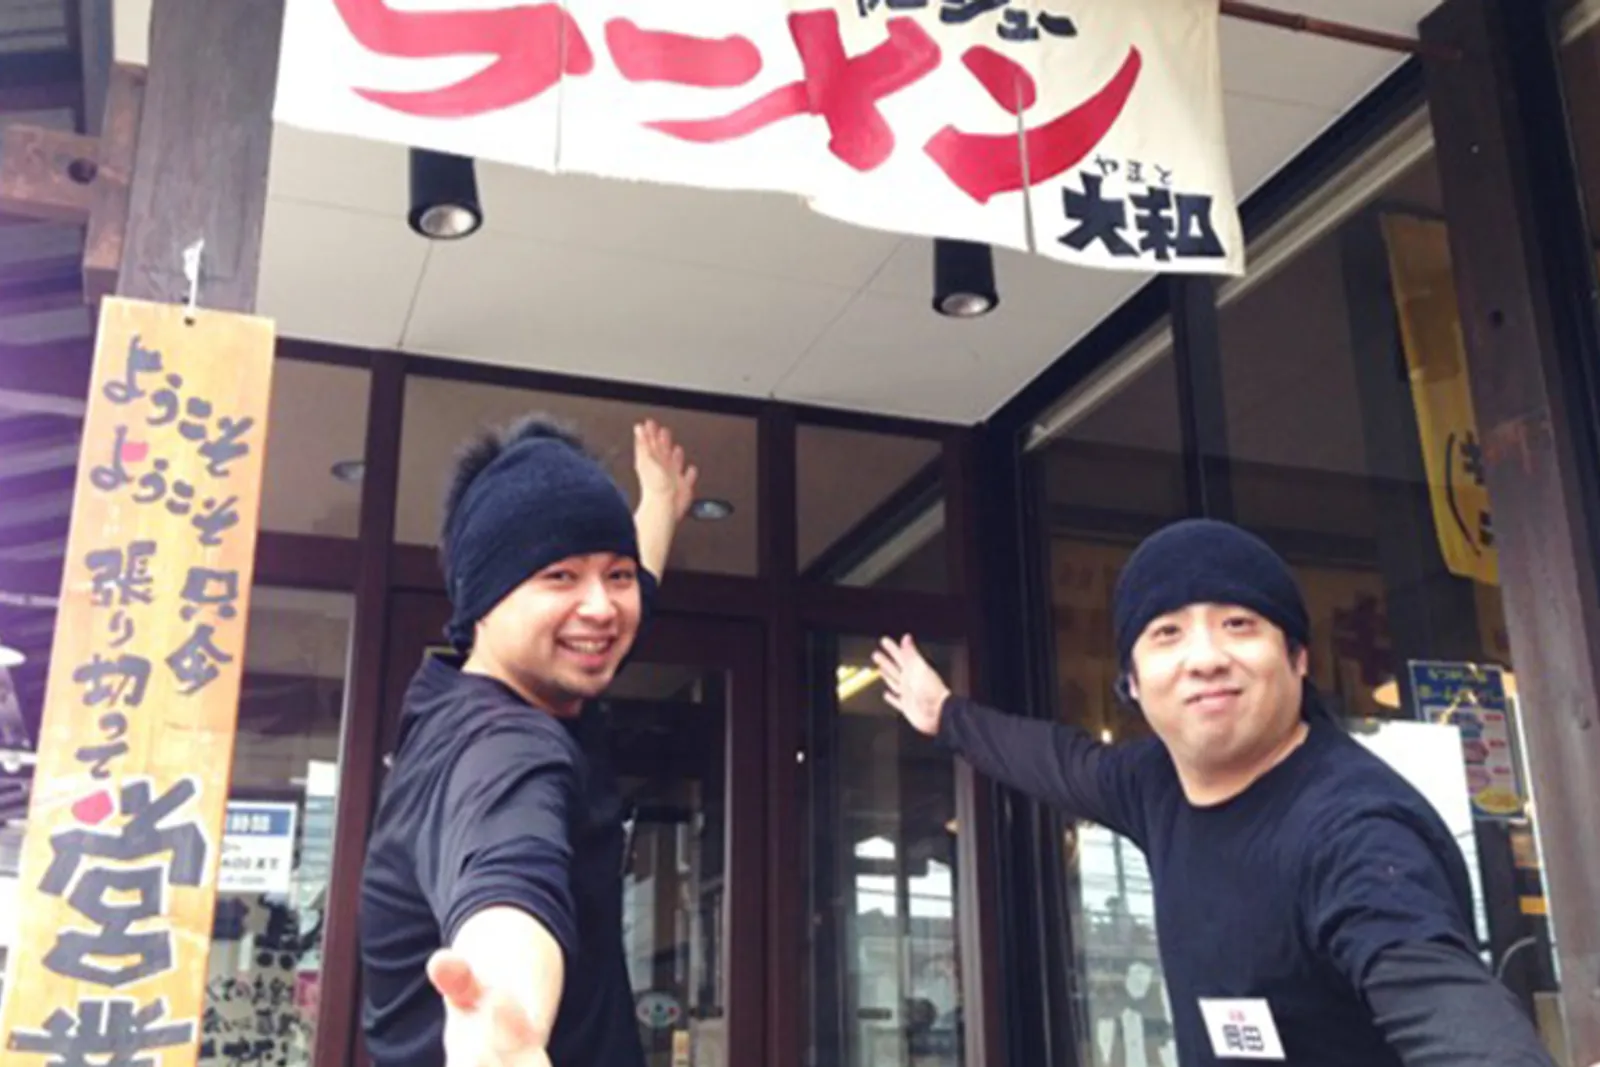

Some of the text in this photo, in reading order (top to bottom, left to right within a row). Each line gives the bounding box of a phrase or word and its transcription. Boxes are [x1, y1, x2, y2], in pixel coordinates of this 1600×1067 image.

[330, 0, 1142, 206] ラーメン
[1056, 170, 1227, 262] 大和
[1094, 154, 1173, 186] やまと
[102, 334, 254, 478] ようこそ
[89, 424, 240, 547] ようこそ
[71, 540, 157, 779] 張り切って
